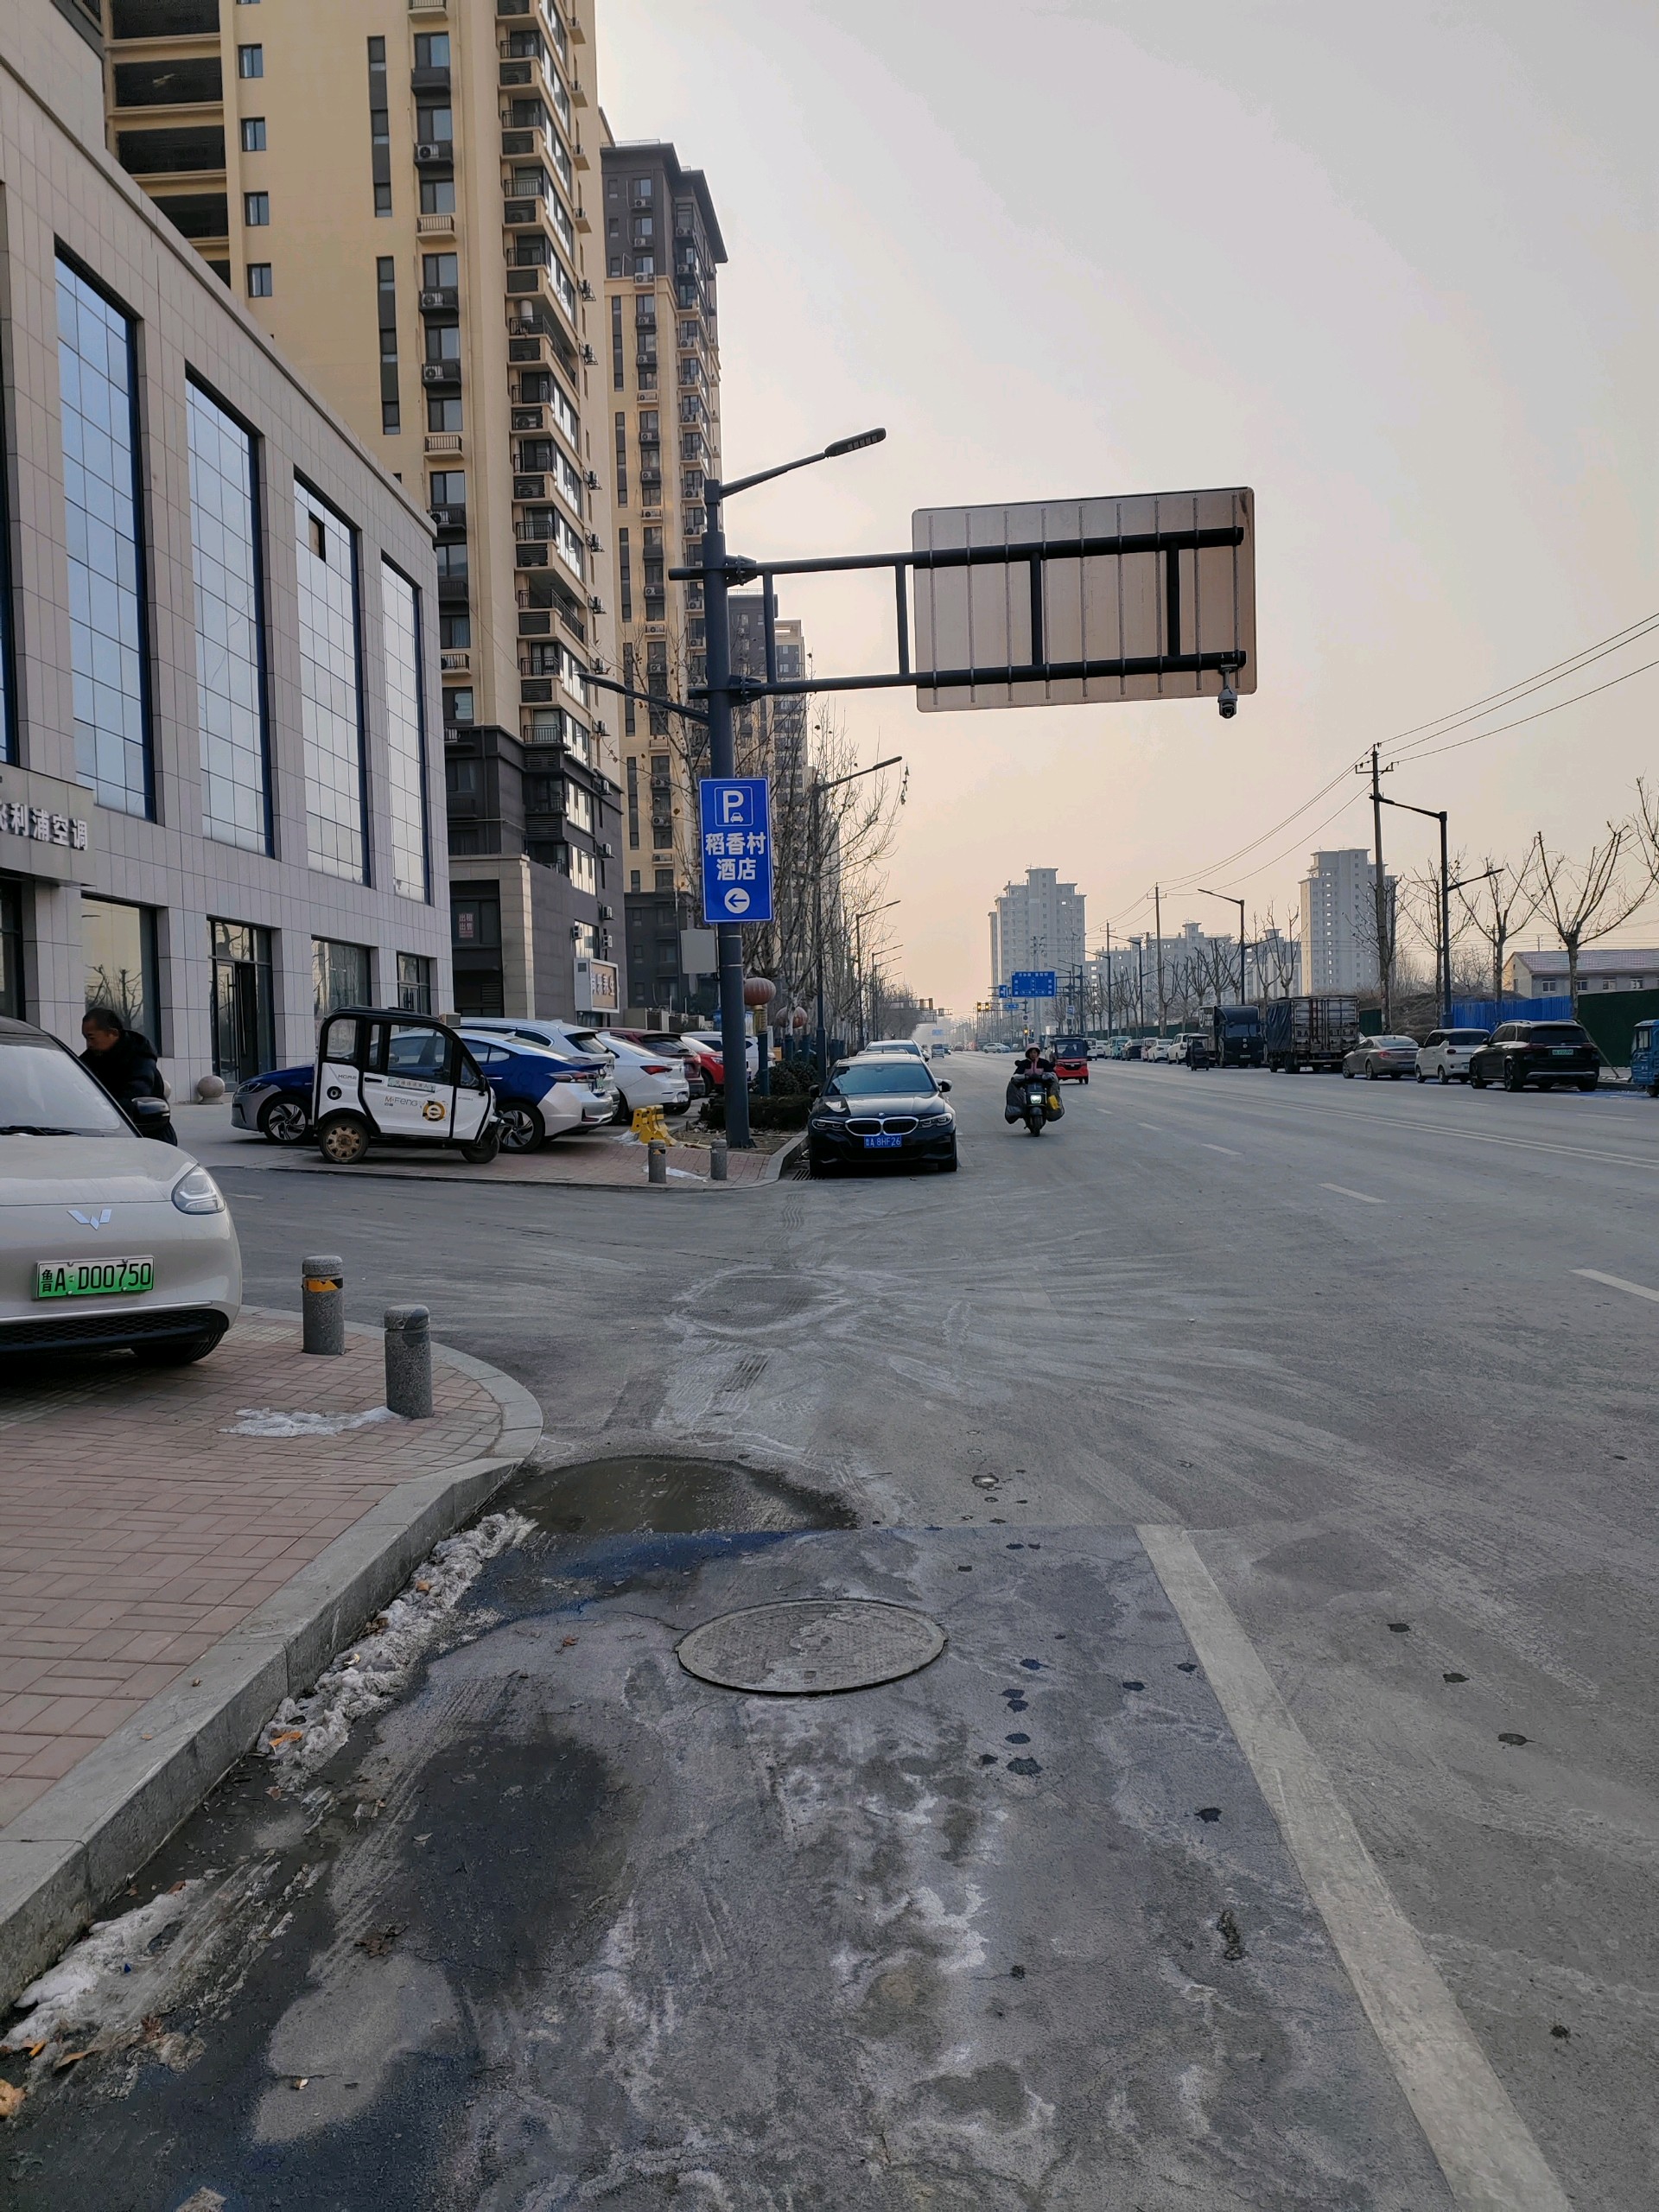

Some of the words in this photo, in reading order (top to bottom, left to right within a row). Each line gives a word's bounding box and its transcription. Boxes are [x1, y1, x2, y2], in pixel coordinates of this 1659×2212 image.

[722, 790, 744, 823] P
[705, 832, 766, 855] 稻香村
[716, 857, 757, 880] 酒店
